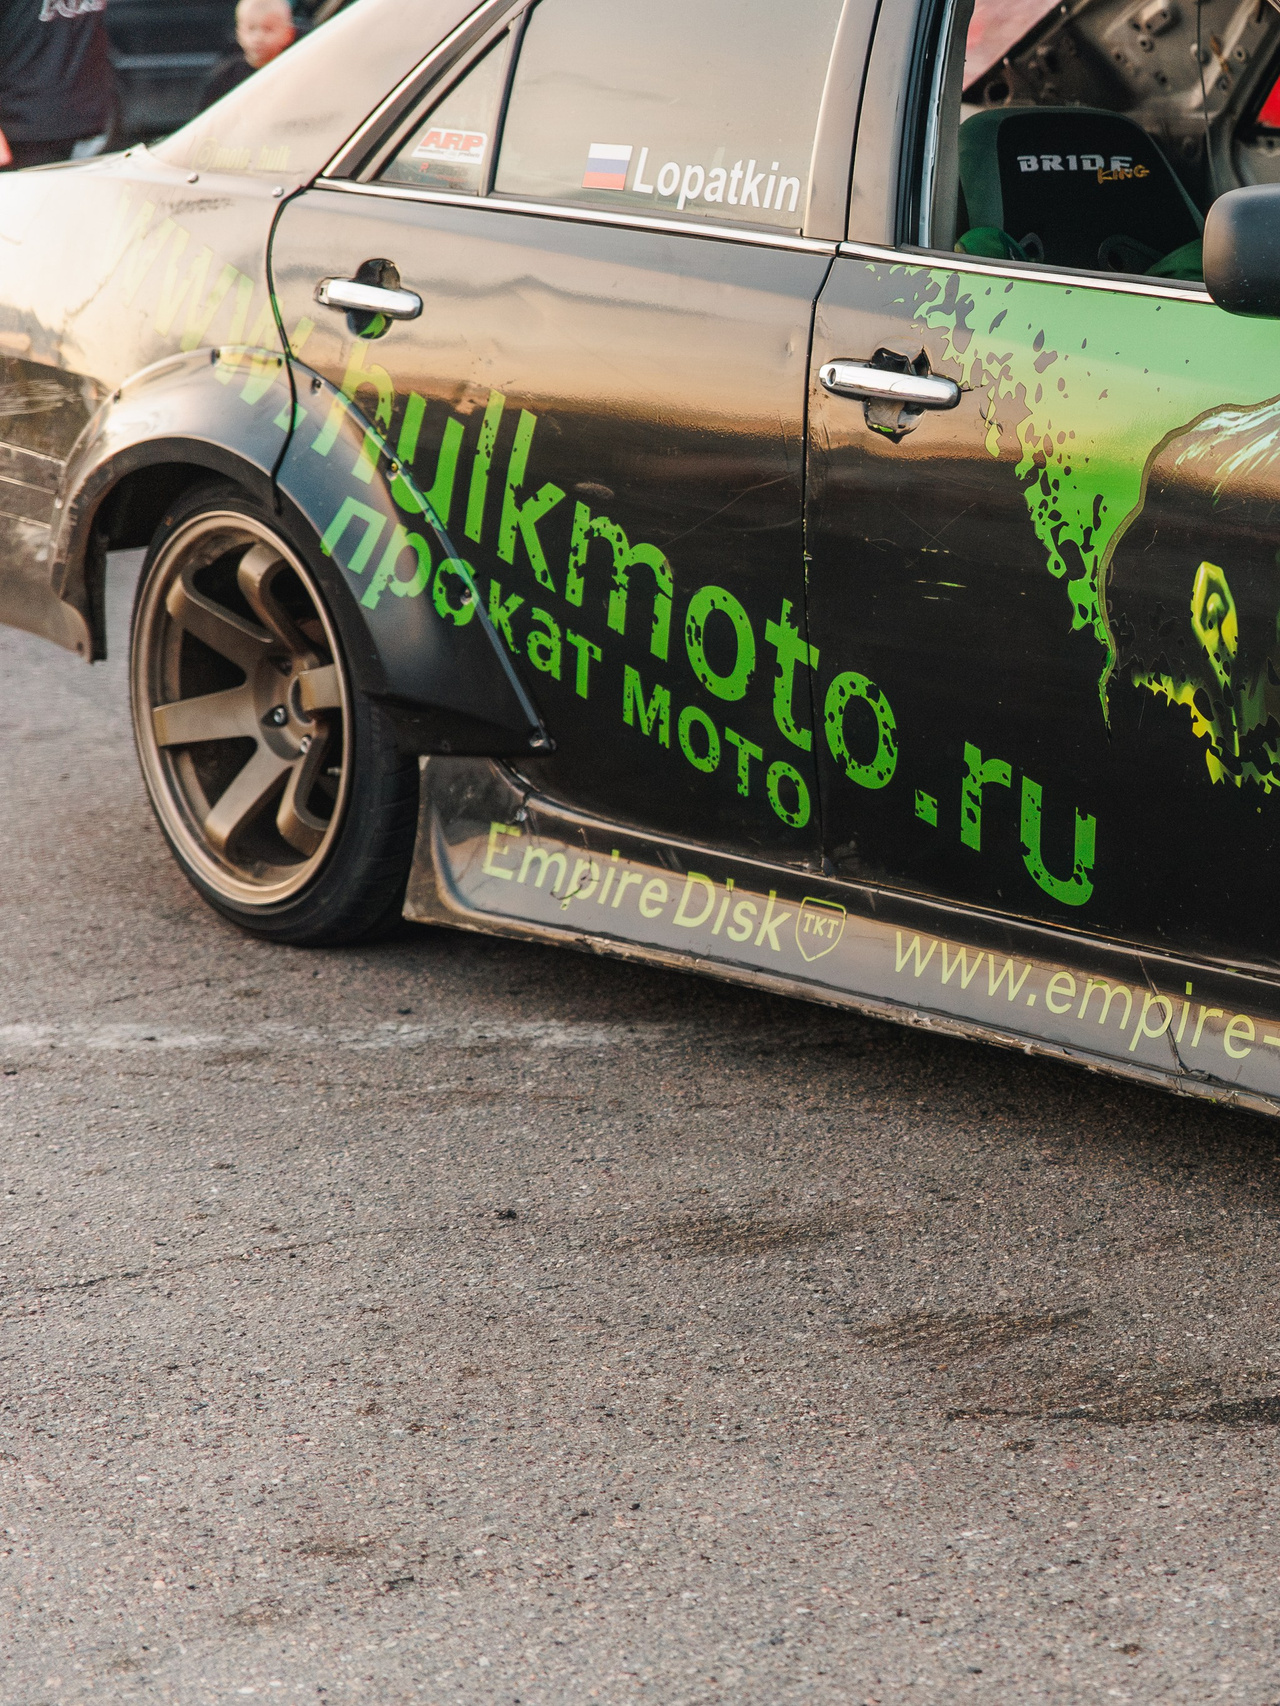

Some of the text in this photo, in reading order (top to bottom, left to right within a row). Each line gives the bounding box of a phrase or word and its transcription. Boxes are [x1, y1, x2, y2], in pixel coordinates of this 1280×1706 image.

[419, 130, 484, 152] ARP
[1016, 154, 1133, 173] BRIDE
[632, 146, 801, 212] Lopatkin
[100, 185, 1097, 906] www.hulkmoto.ru
[803, 912, 840, 939] TKT
